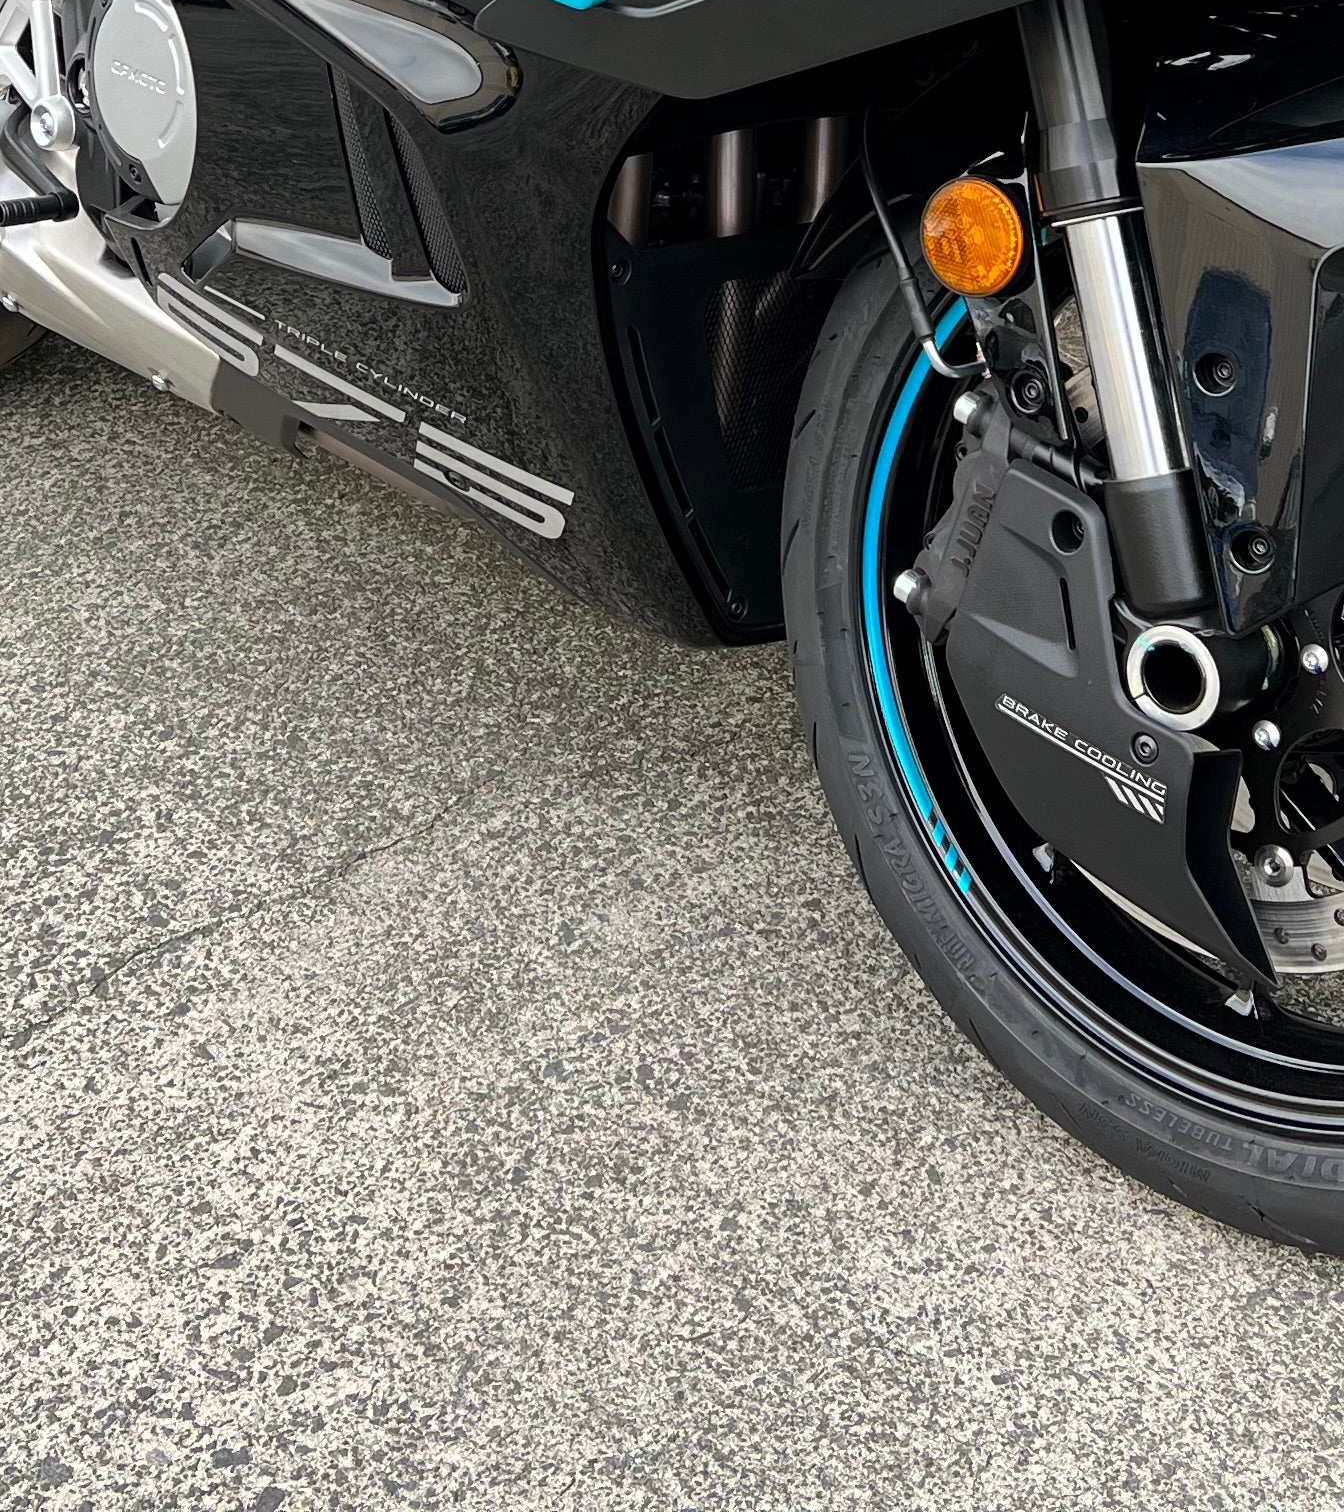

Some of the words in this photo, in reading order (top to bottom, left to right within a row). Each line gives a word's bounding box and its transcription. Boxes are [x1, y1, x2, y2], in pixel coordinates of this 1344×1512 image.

[273, 318, 347, 363] TRIPLE
[355, 361, 467, 424] CYLINDER
[951, 481, 996, 579] J.JUAN
[1001, 694, 1069, 742] BRAKE
[1074, 737, 1168, 795] COOLING
[1124, 1091, 1243, 1156] TUBELESS
